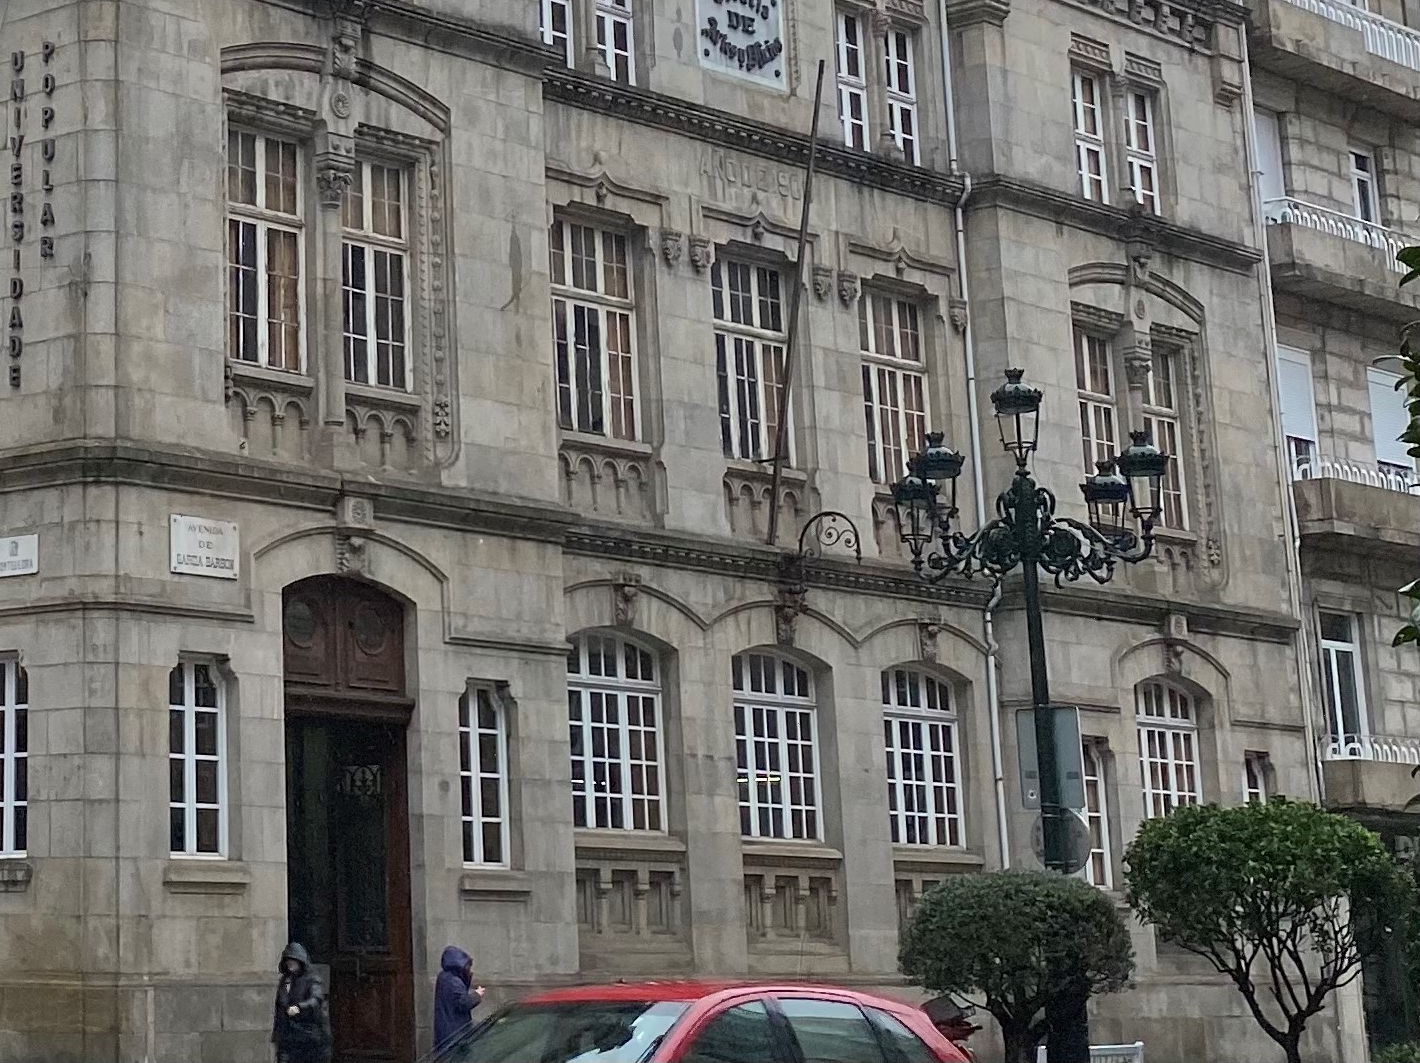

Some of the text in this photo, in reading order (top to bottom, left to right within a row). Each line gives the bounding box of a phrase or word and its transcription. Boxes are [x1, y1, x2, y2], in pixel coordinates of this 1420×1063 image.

[727, 9, 756, 35] DE
[40, 41, 56, 259] POPULAR
[9, 50, 26, 388] UNIVERSIDADE
[188, 523, 223, 535] AVENIDA
[198, 540, 213, 550] DE
